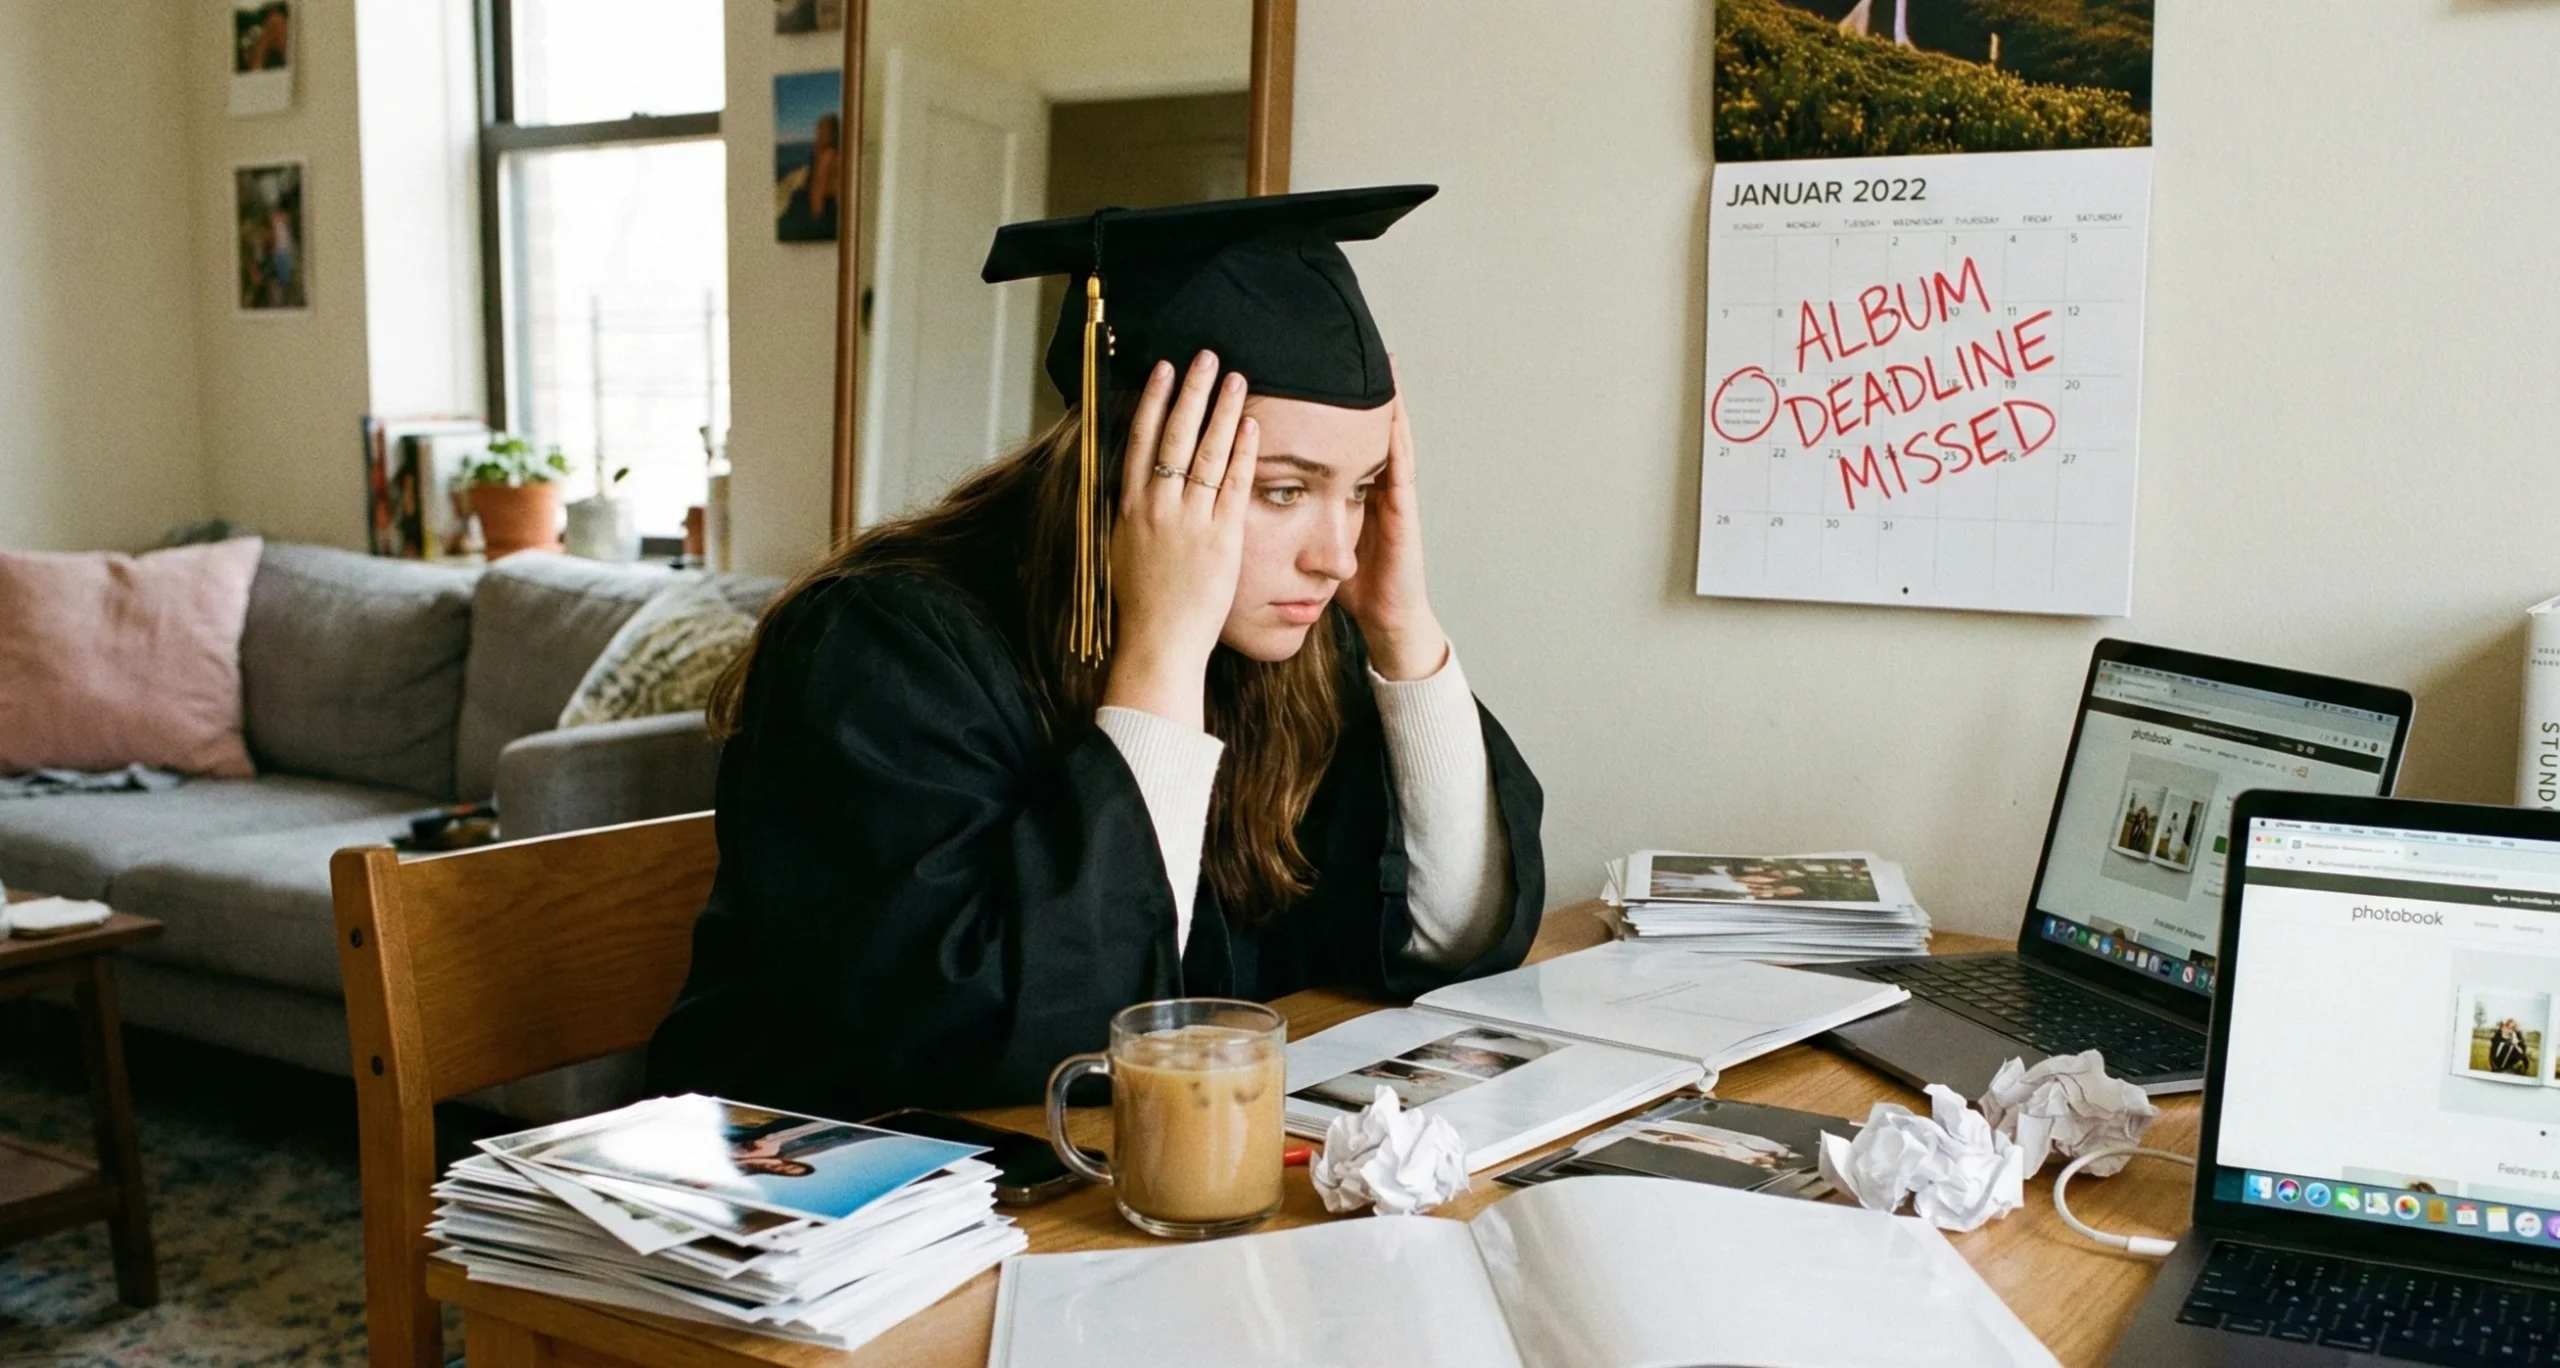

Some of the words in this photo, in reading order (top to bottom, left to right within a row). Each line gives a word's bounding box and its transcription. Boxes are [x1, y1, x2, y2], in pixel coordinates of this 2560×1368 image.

[1726, 181, 1843, 206] JANUAR
[1852, 178, 1927, 202] 2022
[2022, 215, 2052, 223] FRIDAY
[2076, 213, 2123, 222] SATURDAY
[1892, 237, 1899, 246] 2
[1950, 235, 1957, 245] 3
[2009, 235, 2017, 243] 4
[2070, 233, 2078, 242] 5
[1722, 309, 1729, 319] 7
[2007, 306, 2017, 316] 11
[2067, 306, 2080, 316] 12
[1796, 256, 1991, 373] ALBUM
[1784, 310, 2054, 448] DEADLINE
[2064, 380, 2080, 390] 20
[1719, 446, 1730, 456] 21
[1773, 447, 1786, 458] 22
[1943, 450, 1957, 461] 25
[2062, 453, 2076, 464] 27
[1839, 400, 2056, 510] MISSED
[1825, 518, 1840, 529] 30
[2352, 904, 2444, 926] photobook
